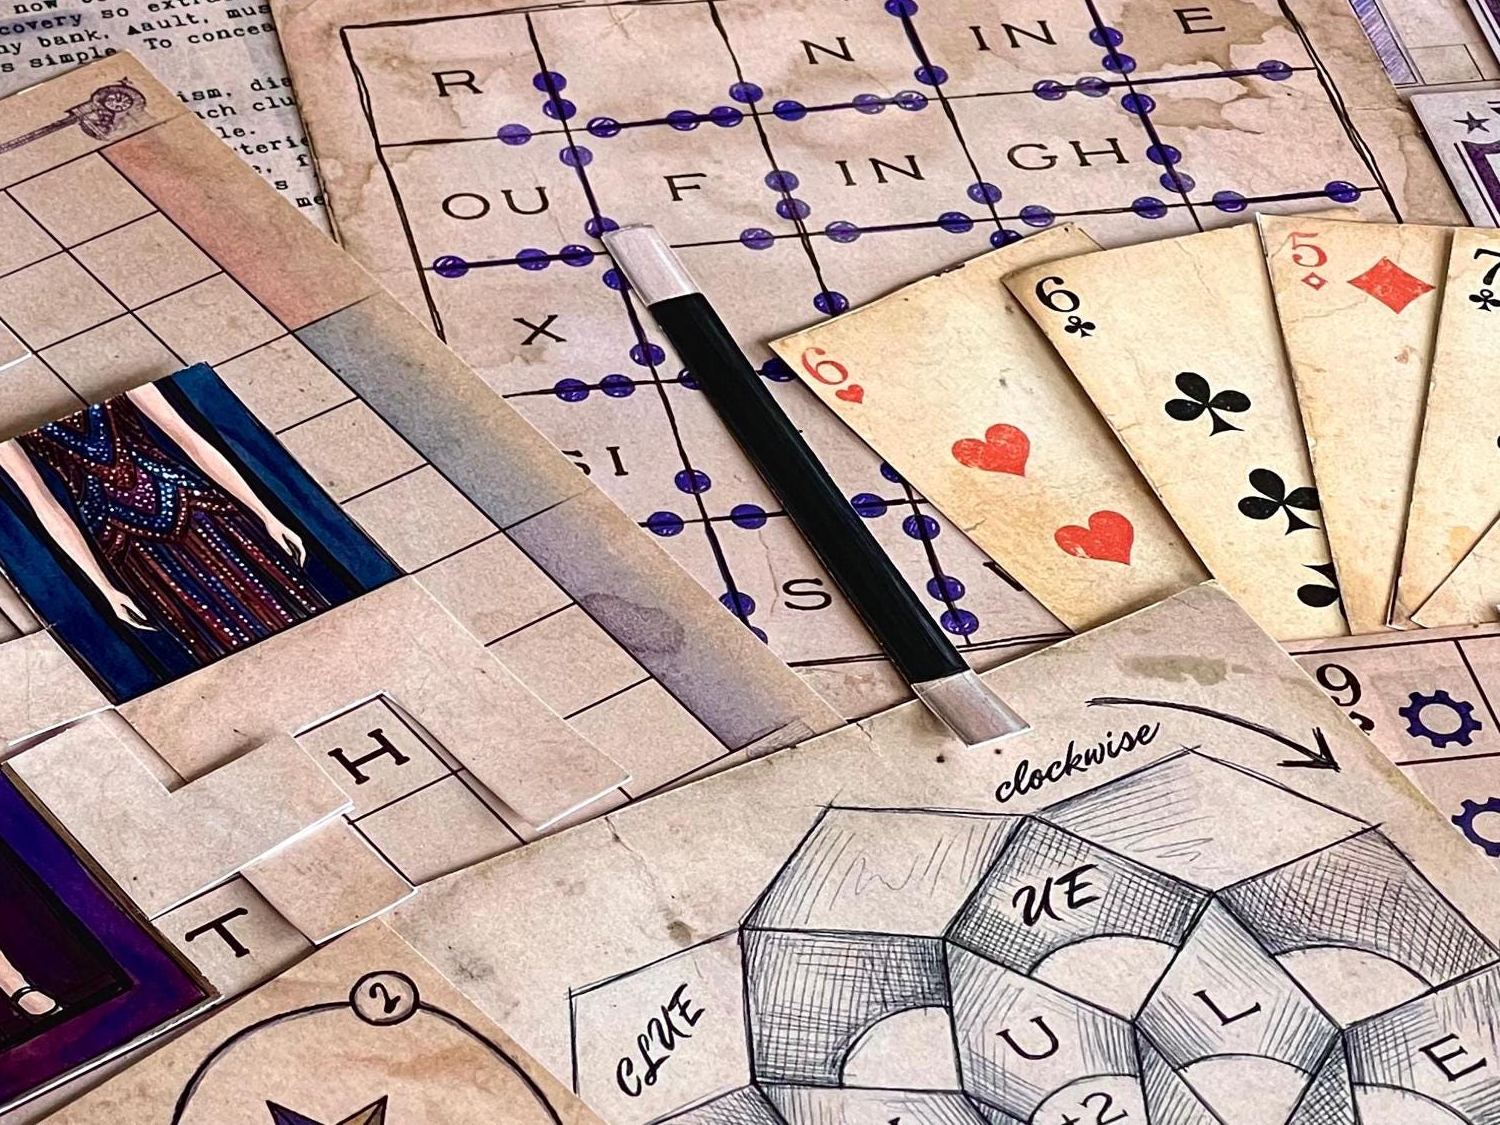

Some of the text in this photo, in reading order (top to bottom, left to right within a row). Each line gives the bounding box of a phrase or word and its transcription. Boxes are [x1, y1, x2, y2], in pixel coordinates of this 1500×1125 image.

[432, 5, 1227, 101] R N IN E
[438, 136, 1131, 224] OU F IN GH
[1286, 231, 1329, 268] 5
[1033, 274, 1081, 314] 6
[518, 314, 567, 347] X
[800, 345, 849, 387] 6
[782, 577, 833, 612] S
[1315, 663, 1362, 707] 9
[327, 727, 413, 785] H
[993, 719, 1166, 805] clockwise
[1011, 862, 1104, 928] UE
[184, 905, 250, 959] T
[367, 982, 402, 1014] 2
[1194, 986, 1263, 1028] L
[616, 982, 708, 1098] CLUE
[996, 1015, 1062, 1062] U
[1419, 1030, 1487, 1083] E
